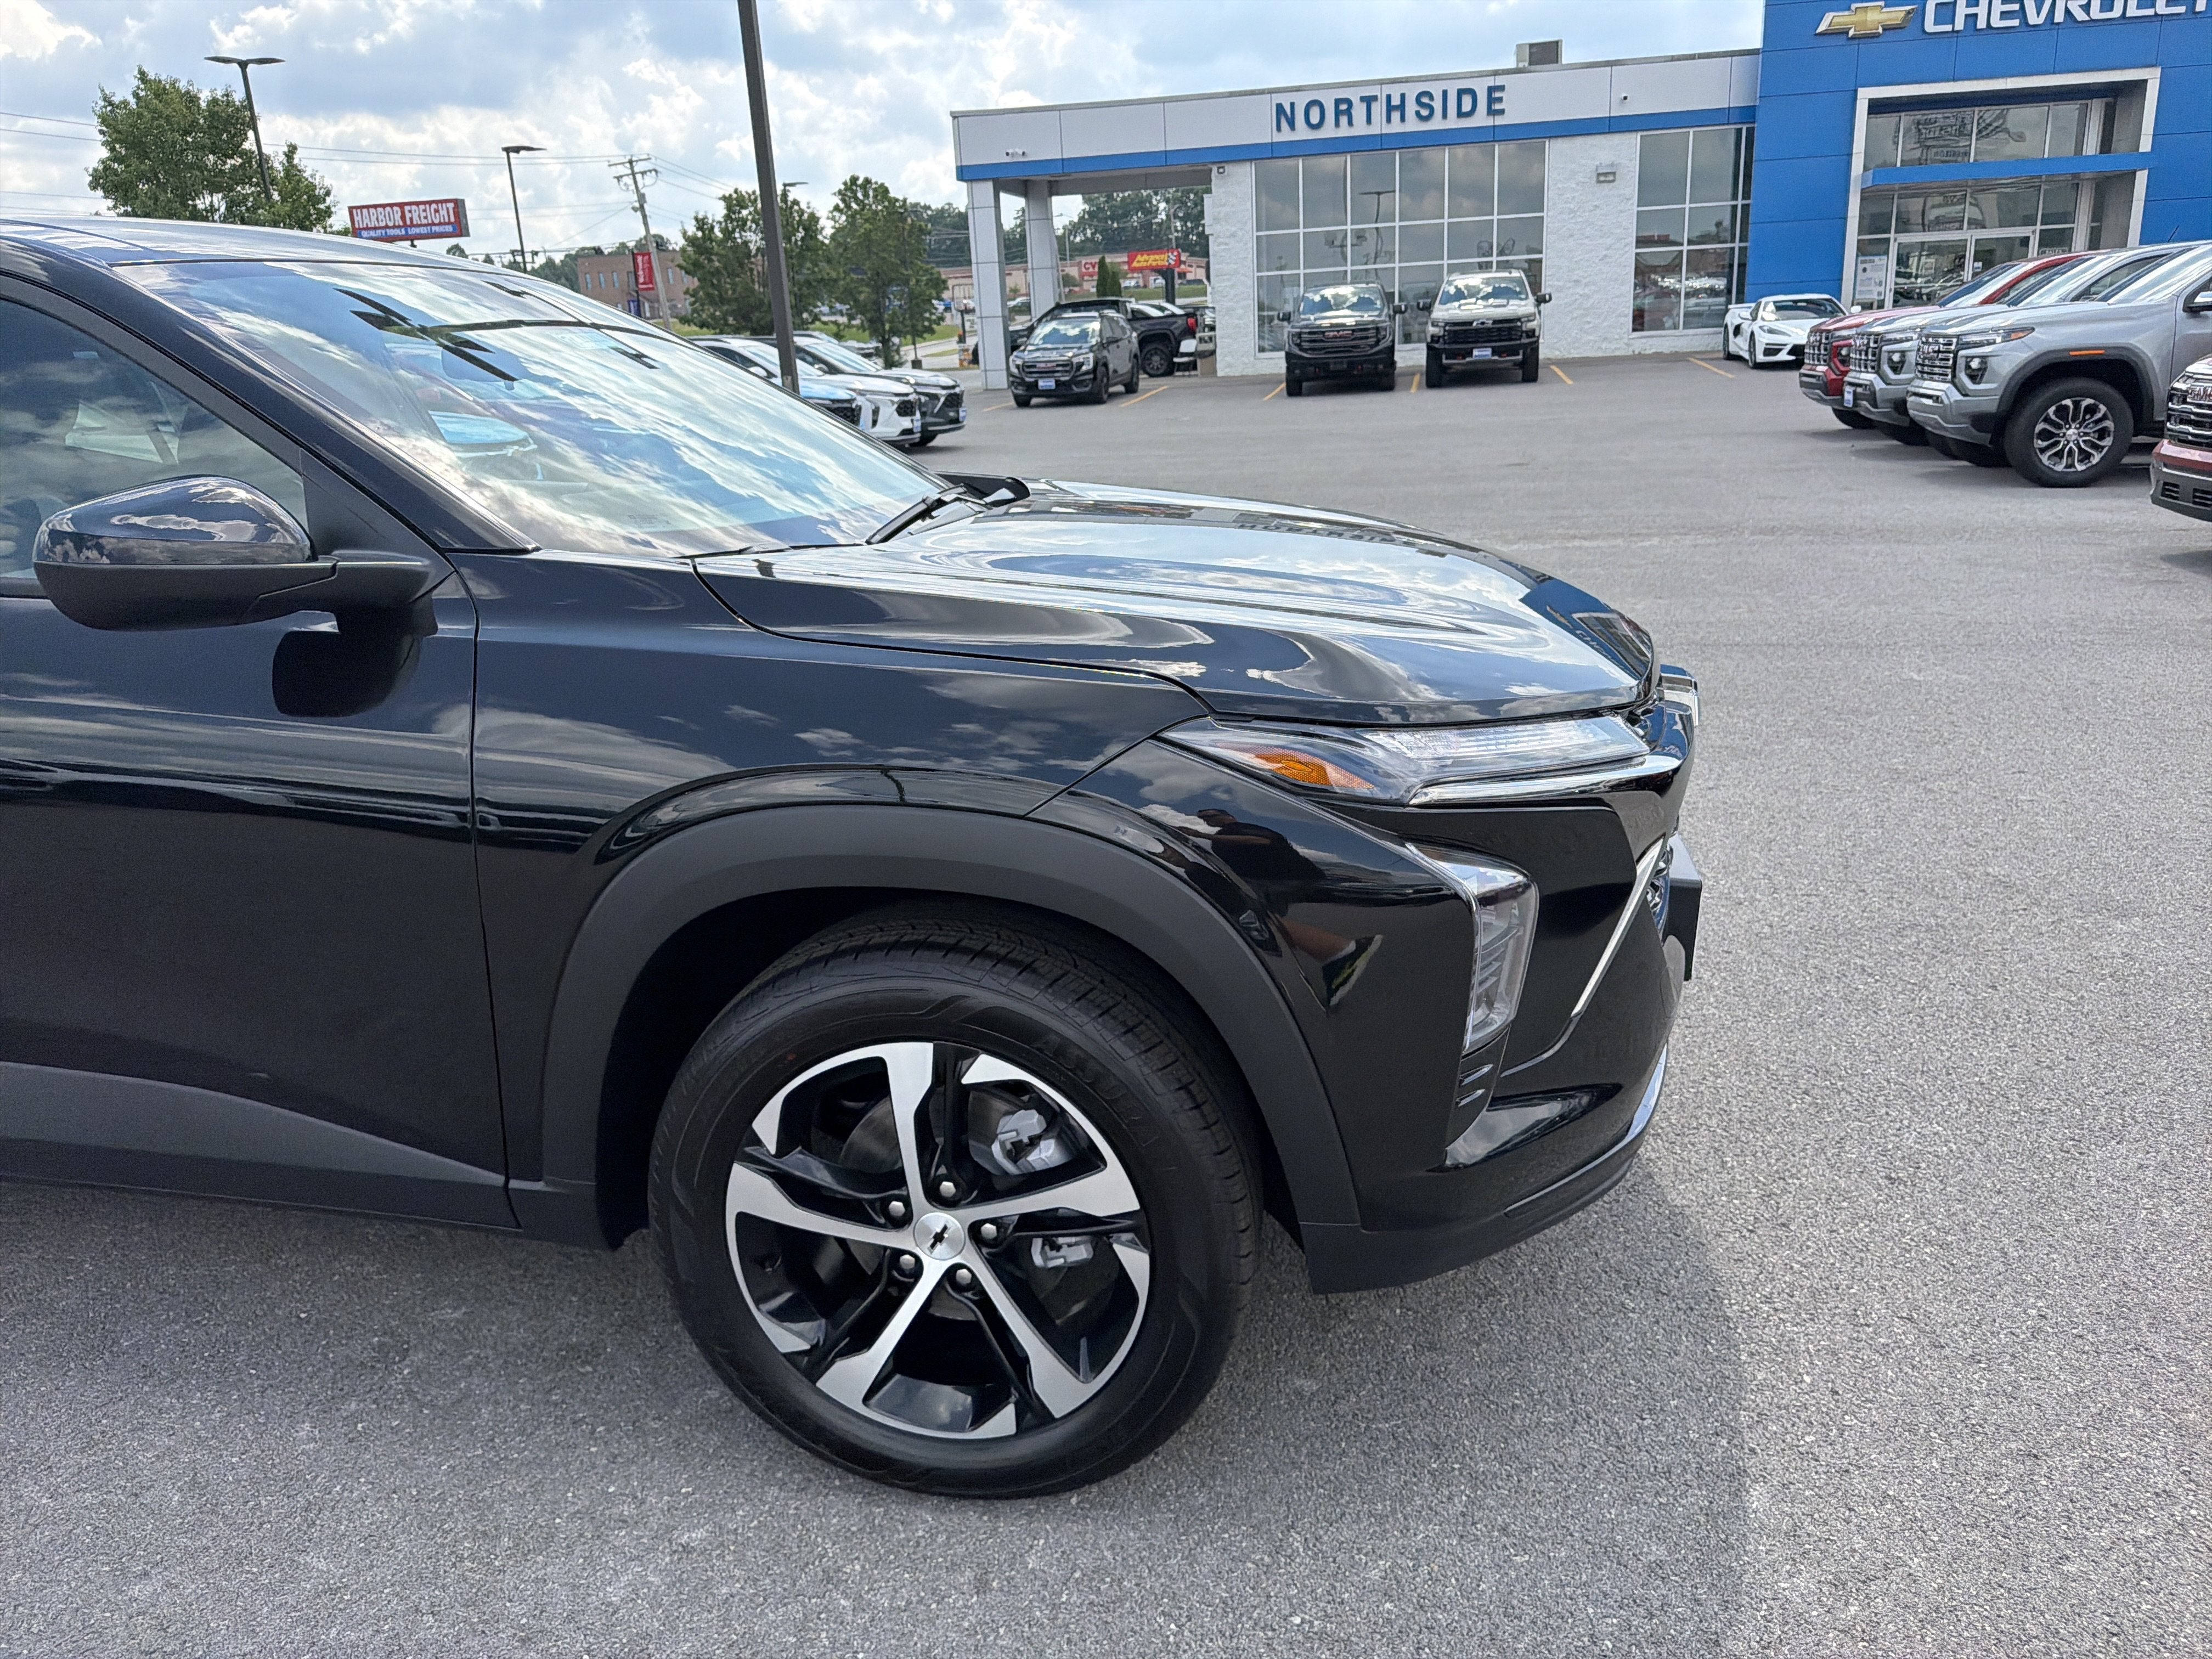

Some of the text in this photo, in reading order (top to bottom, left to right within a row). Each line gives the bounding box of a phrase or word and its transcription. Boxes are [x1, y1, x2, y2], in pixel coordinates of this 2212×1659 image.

[1275, 84, 1505, 132] NORTHSIDE
[353, 202, 455, 228] HARBOR FREIGHT
[360, 224, 453, 238] QUALITY TOOLS LOWEST PRICES
[1084, 261, 1098, 270] CV
